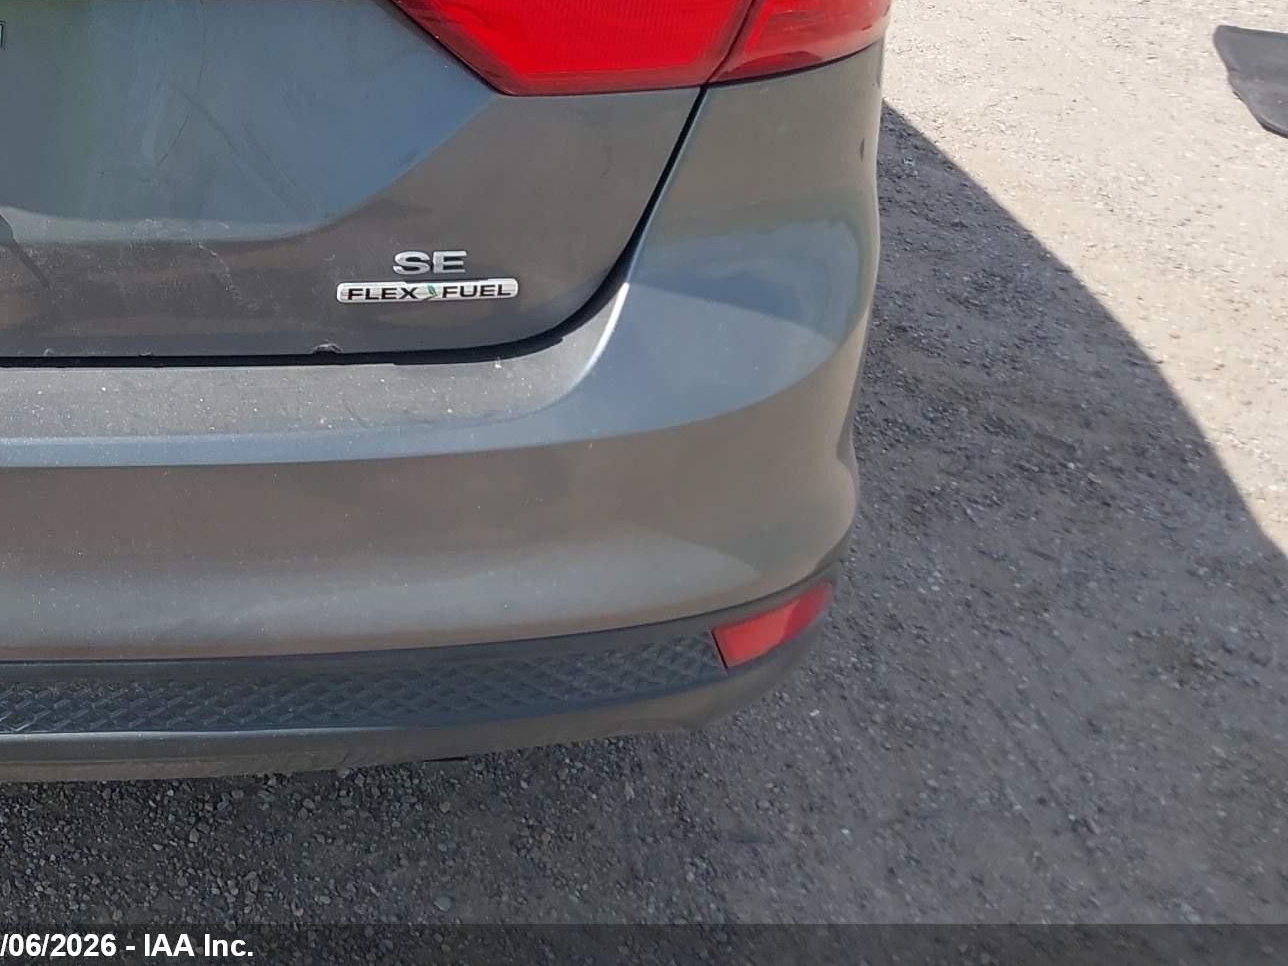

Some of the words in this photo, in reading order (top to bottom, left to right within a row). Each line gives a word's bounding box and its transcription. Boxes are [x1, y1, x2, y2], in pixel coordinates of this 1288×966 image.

[393, 251, 467, 275] SE
[347, 286, 419, 301] FLEX
[442, 284, 512, 298] FUEL
